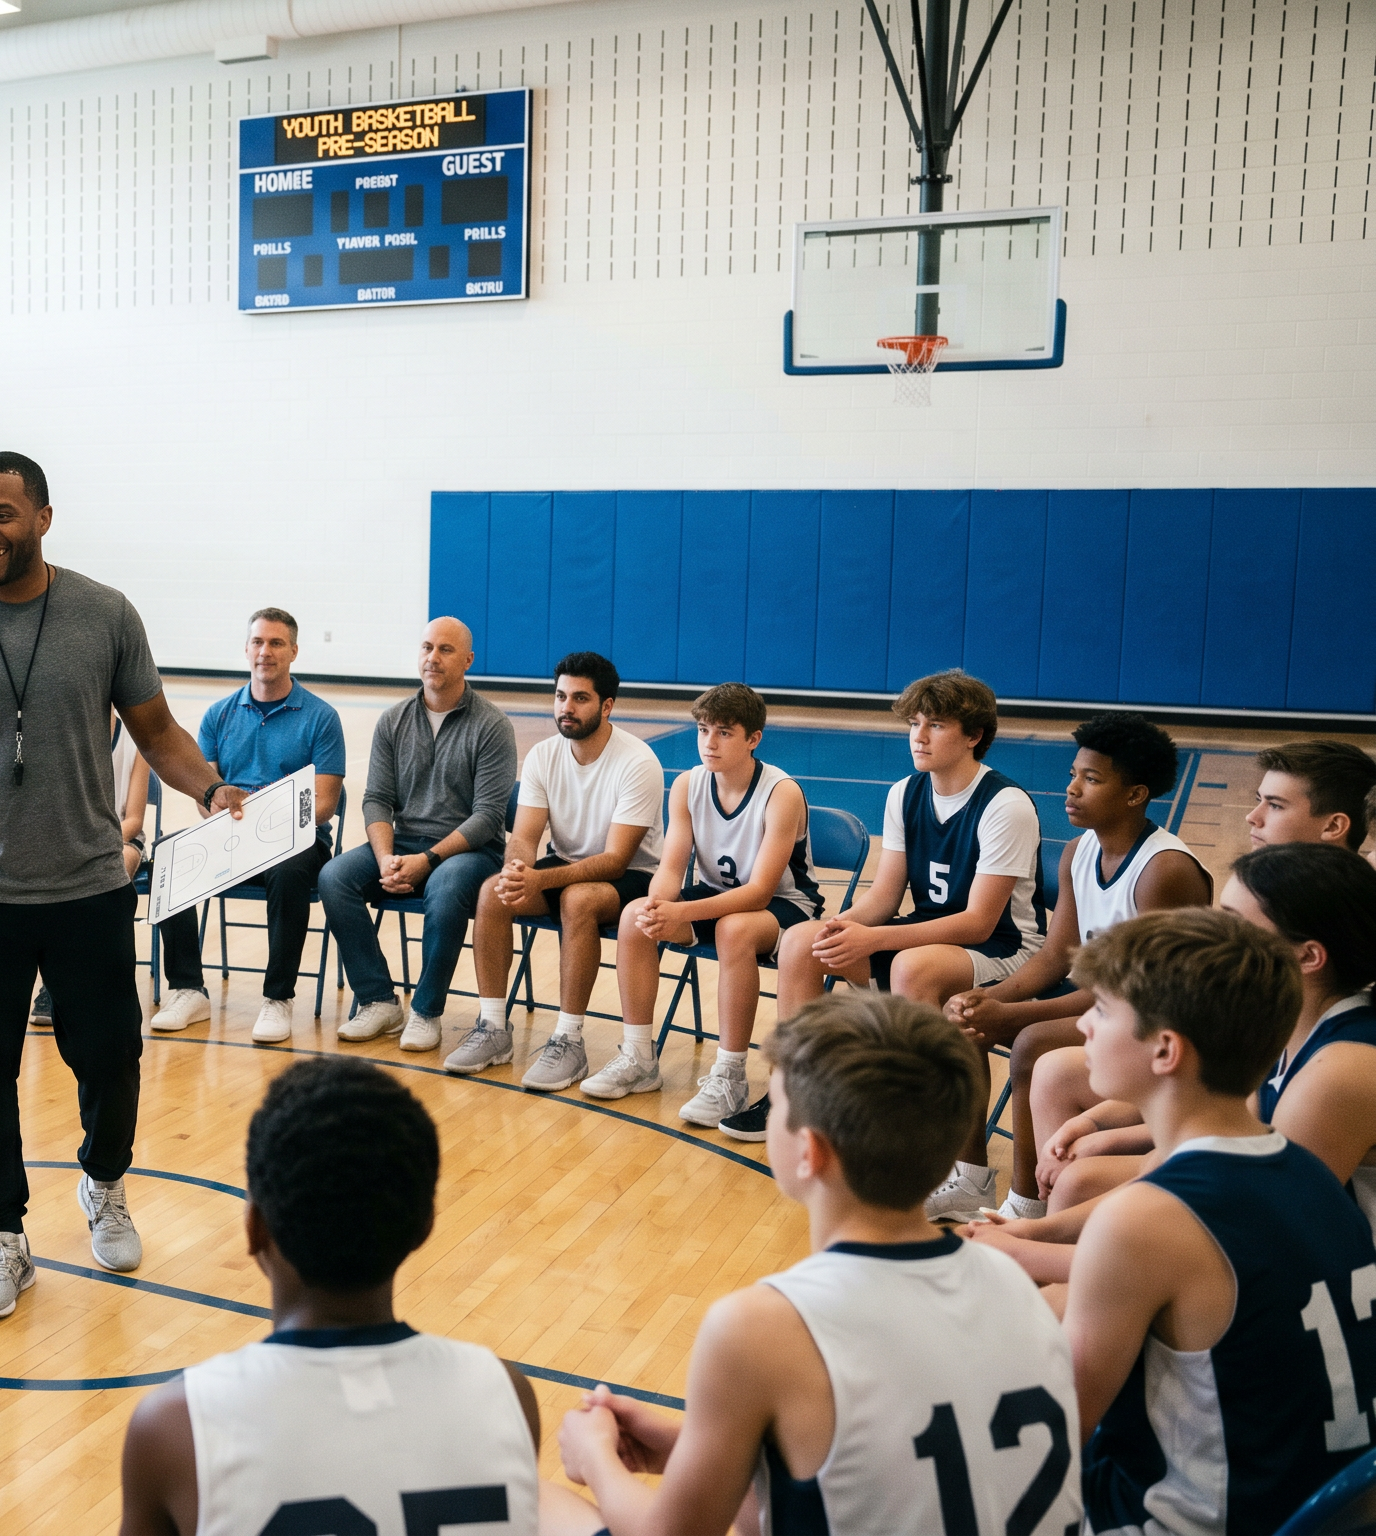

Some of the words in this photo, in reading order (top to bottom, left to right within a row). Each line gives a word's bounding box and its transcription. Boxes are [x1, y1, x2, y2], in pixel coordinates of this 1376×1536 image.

[282, 114, 343, 139] YOUTH
[352, 100, 476, 133] BASKETBALL
[318, 126, 439, 158] PRE-SEASON
[442, 152, 505, 176] GUEST
[928, 860, 951, 905] 5
[913, 1385, 1080, 1536] 12
